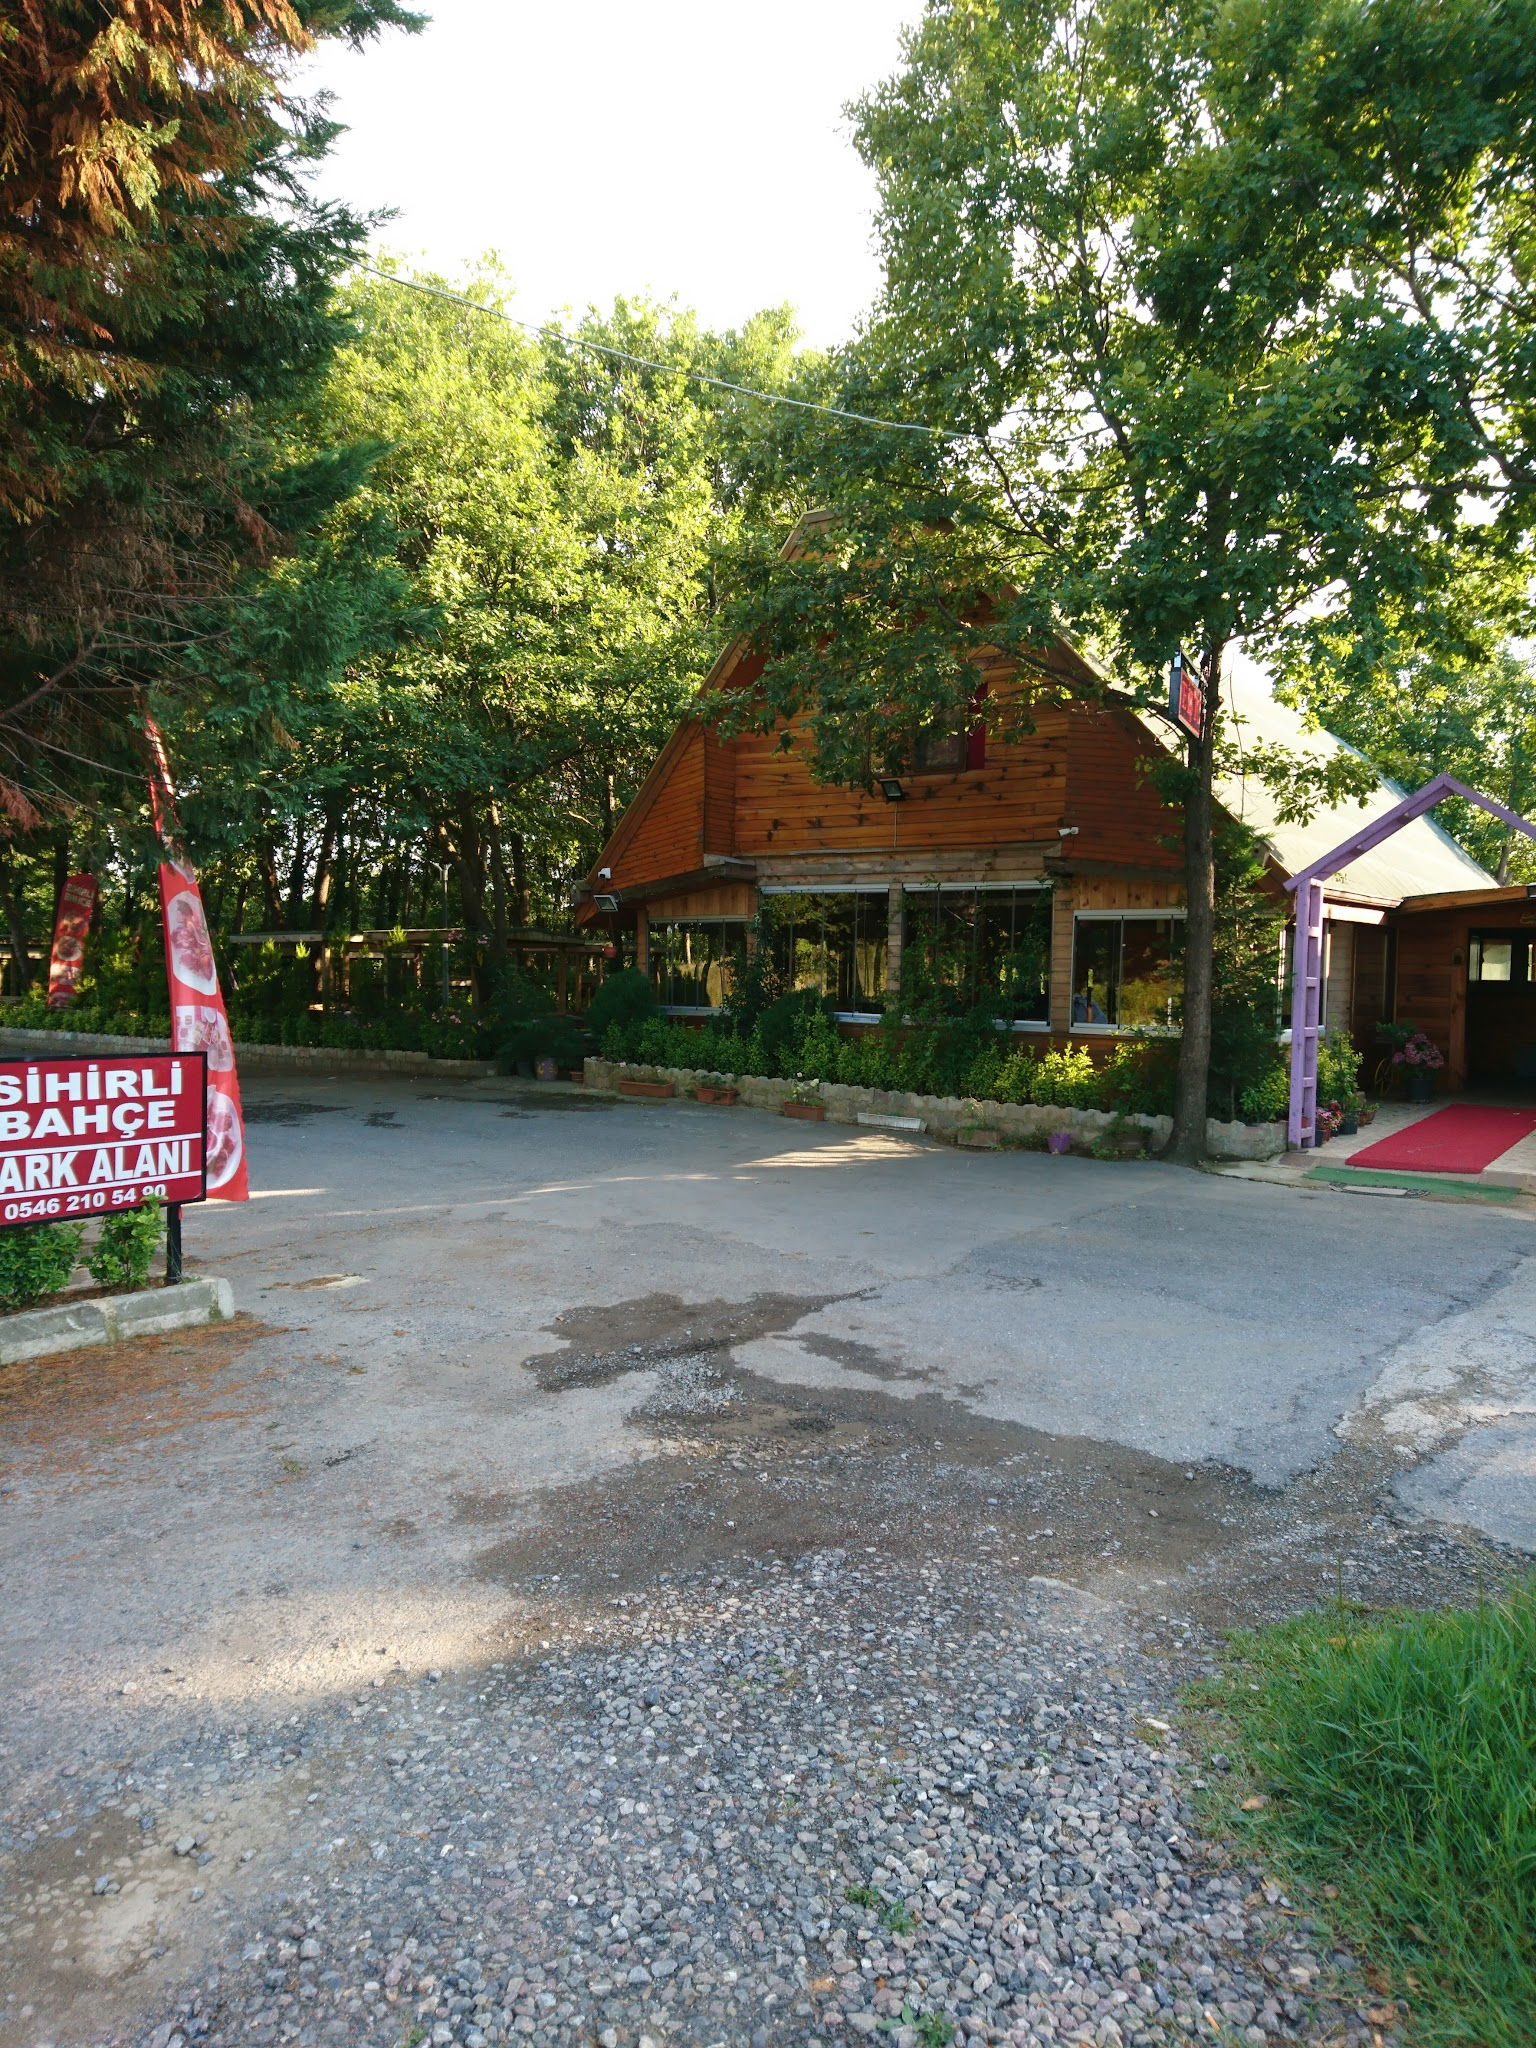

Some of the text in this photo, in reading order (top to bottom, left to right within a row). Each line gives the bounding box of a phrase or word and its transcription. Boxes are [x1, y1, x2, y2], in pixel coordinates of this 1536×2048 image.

[0, 1061, 182, 1107] SİHİRLİ
[0, 1101, 176, 1141] BAHÇE
[88, 1140, 190, 1183] ALANI
[4, 1183, 166, 1220] 0546 210 54 90
